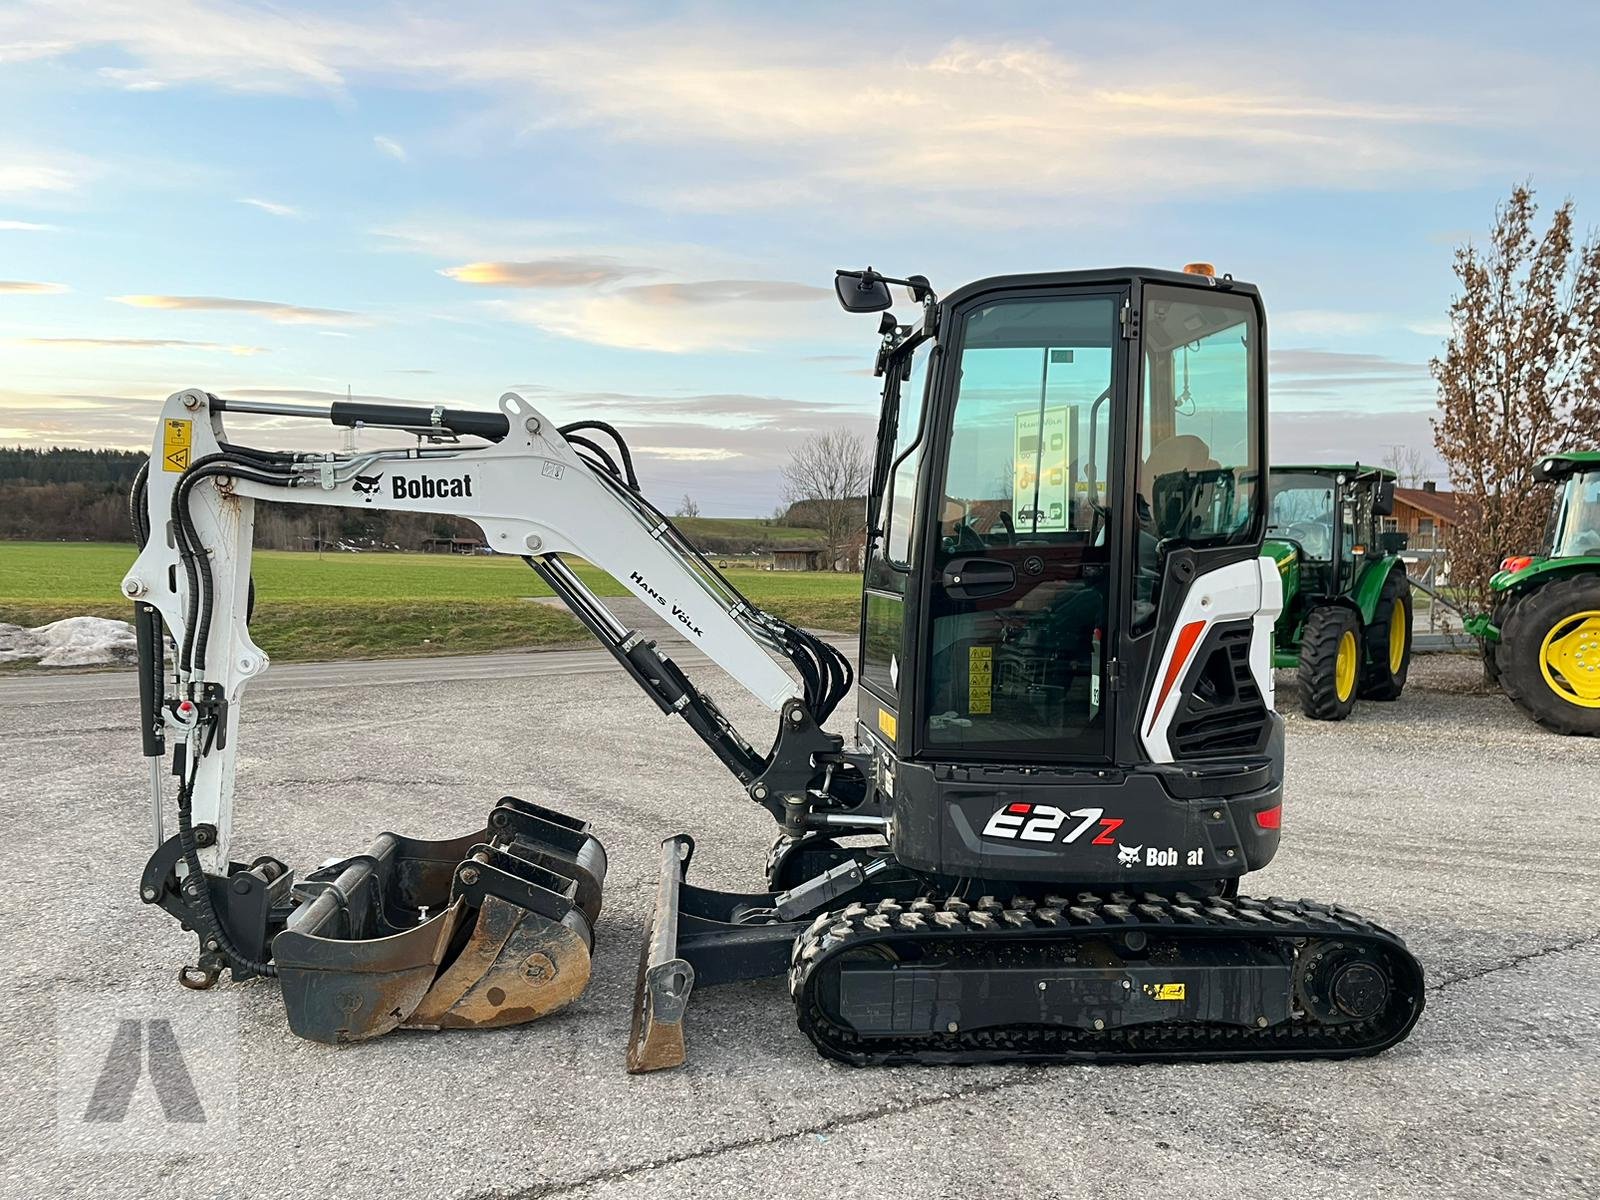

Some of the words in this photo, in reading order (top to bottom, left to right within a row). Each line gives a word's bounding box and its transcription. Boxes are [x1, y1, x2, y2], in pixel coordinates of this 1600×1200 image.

[392, 474, 472, 499] Bobcat
[630, 571, 667, 606] HANS
[672, 605, 704, 637] VÖLK
